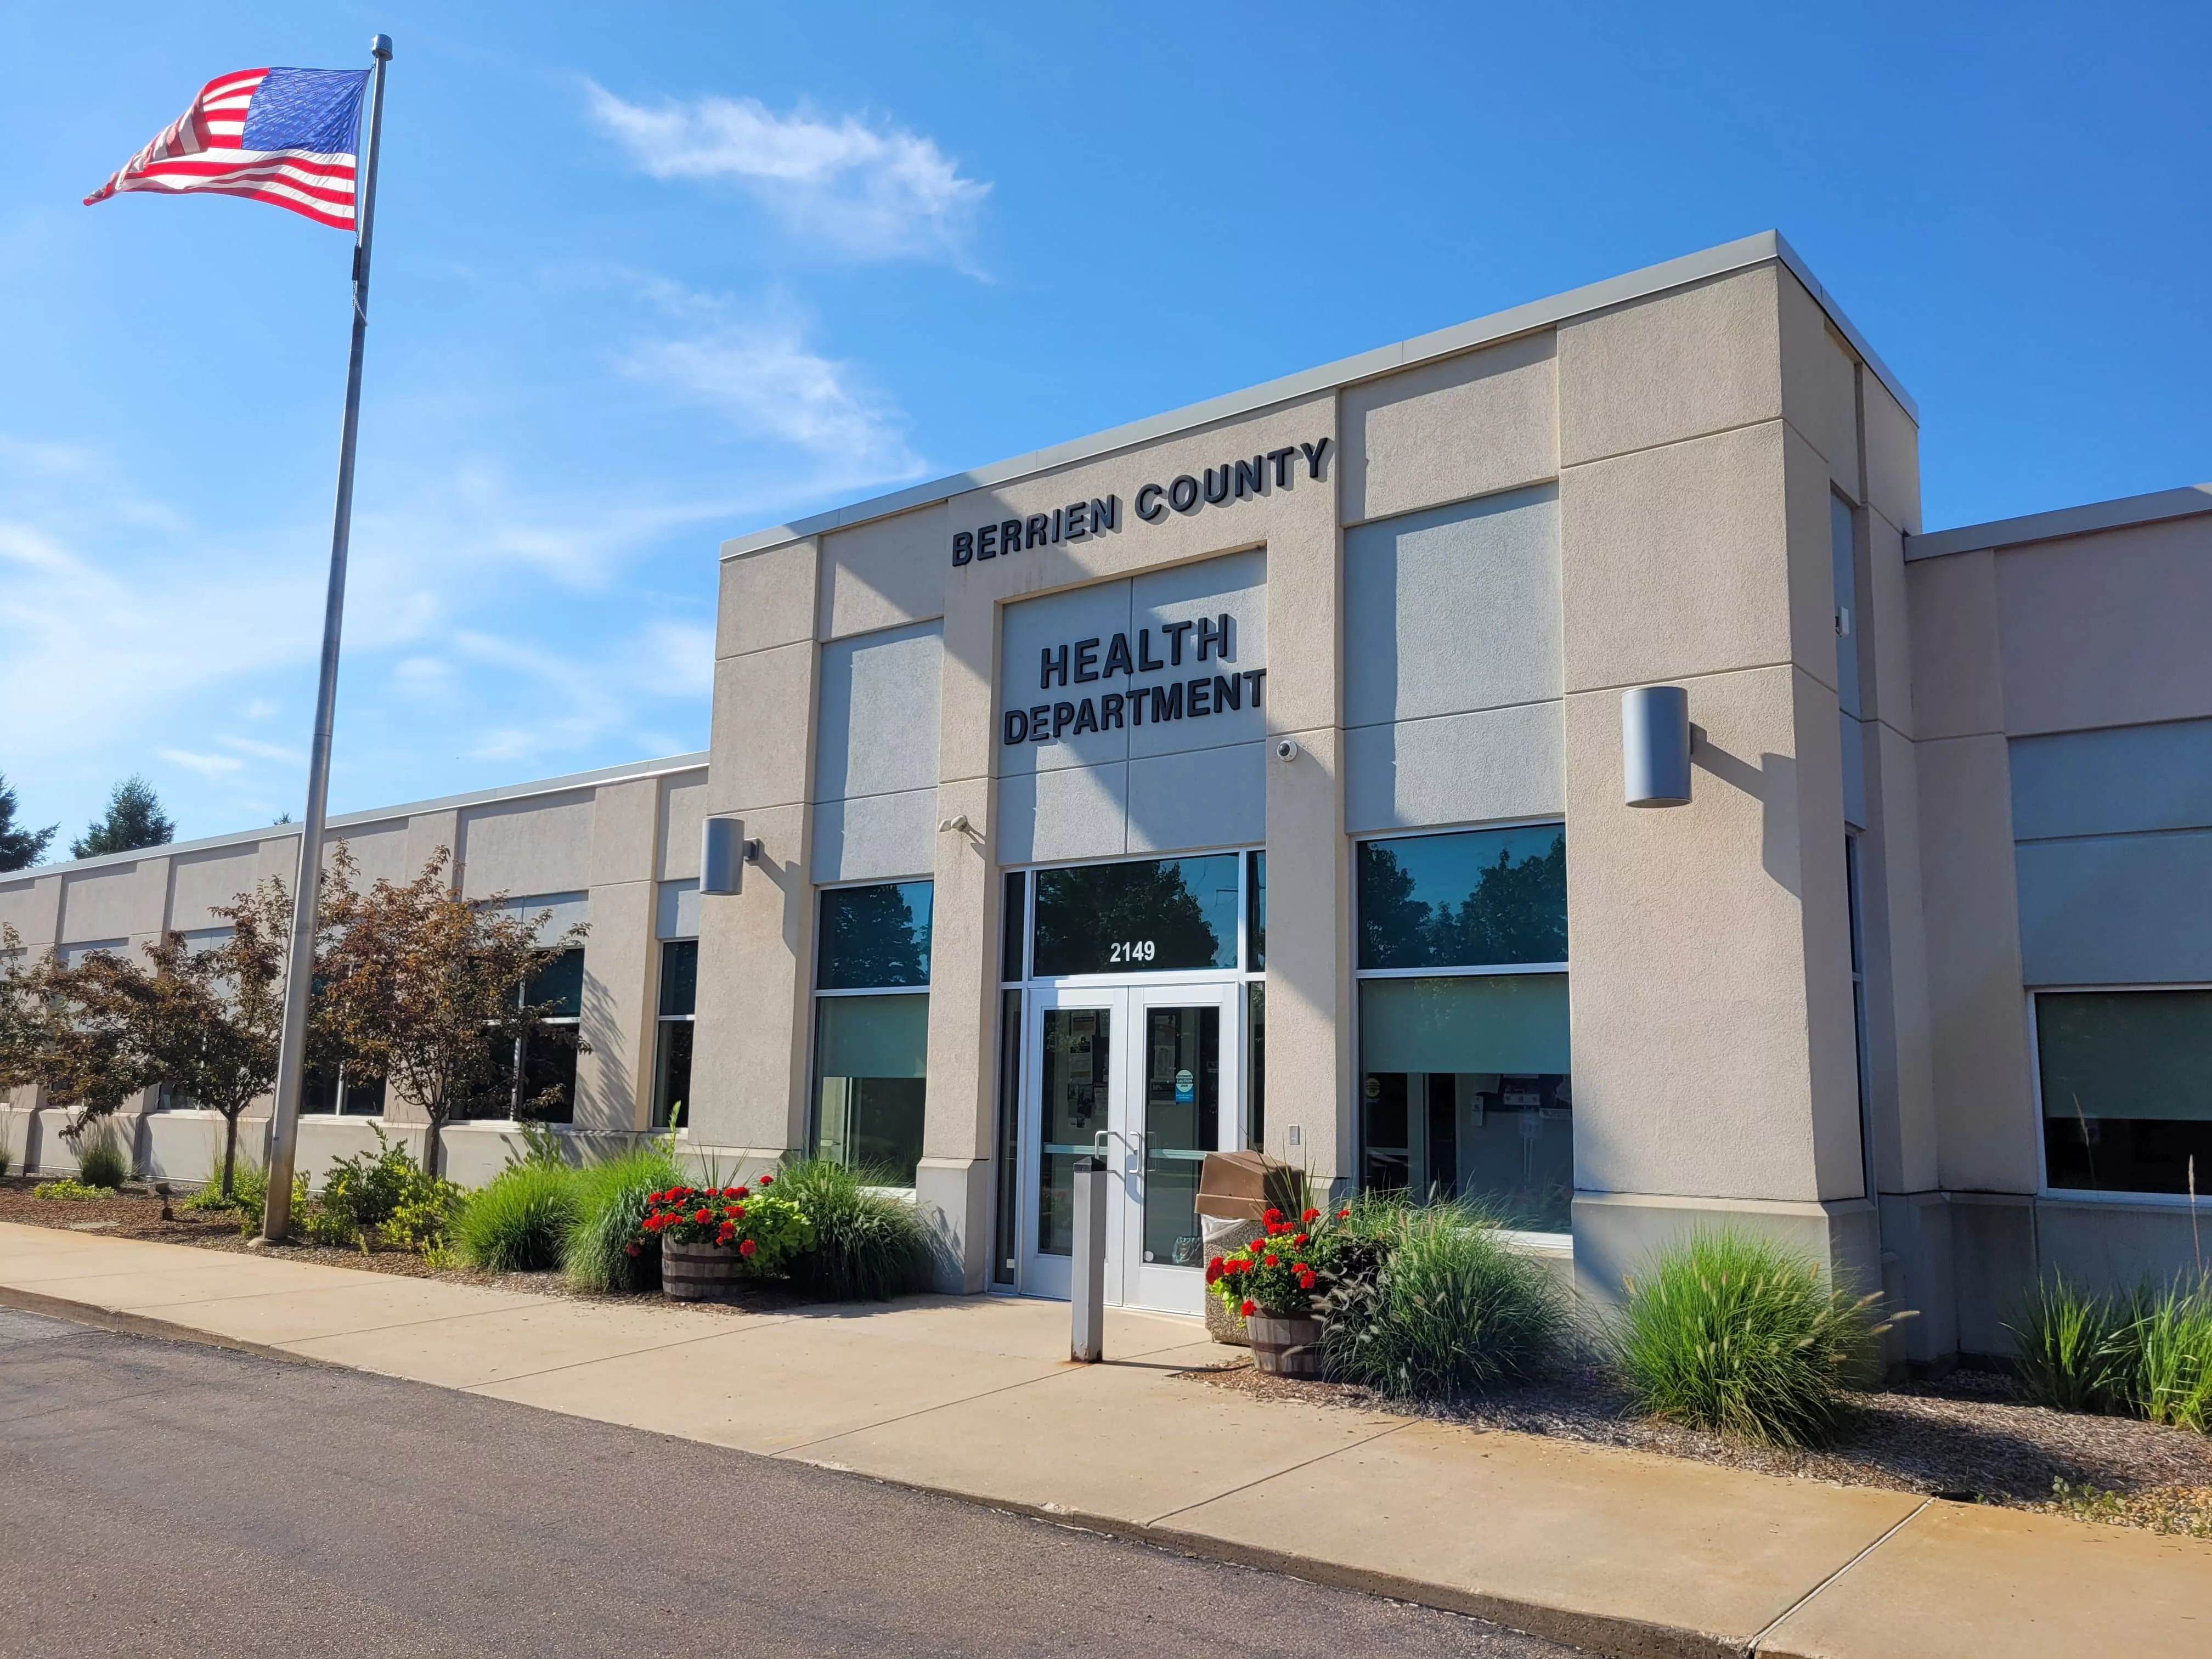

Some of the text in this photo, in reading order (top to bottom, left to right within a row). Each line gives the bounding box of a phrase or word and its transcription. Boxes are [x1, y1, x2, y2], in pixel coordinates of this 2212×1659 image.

[952, 437, 1329, 567] BERRIEN COUNTY
[1040, 613, 1227, 689] HEALTH
[1003, 668, 1267, 745] DEPARTMENT
[1110, 940, 1155, 962] 2149
